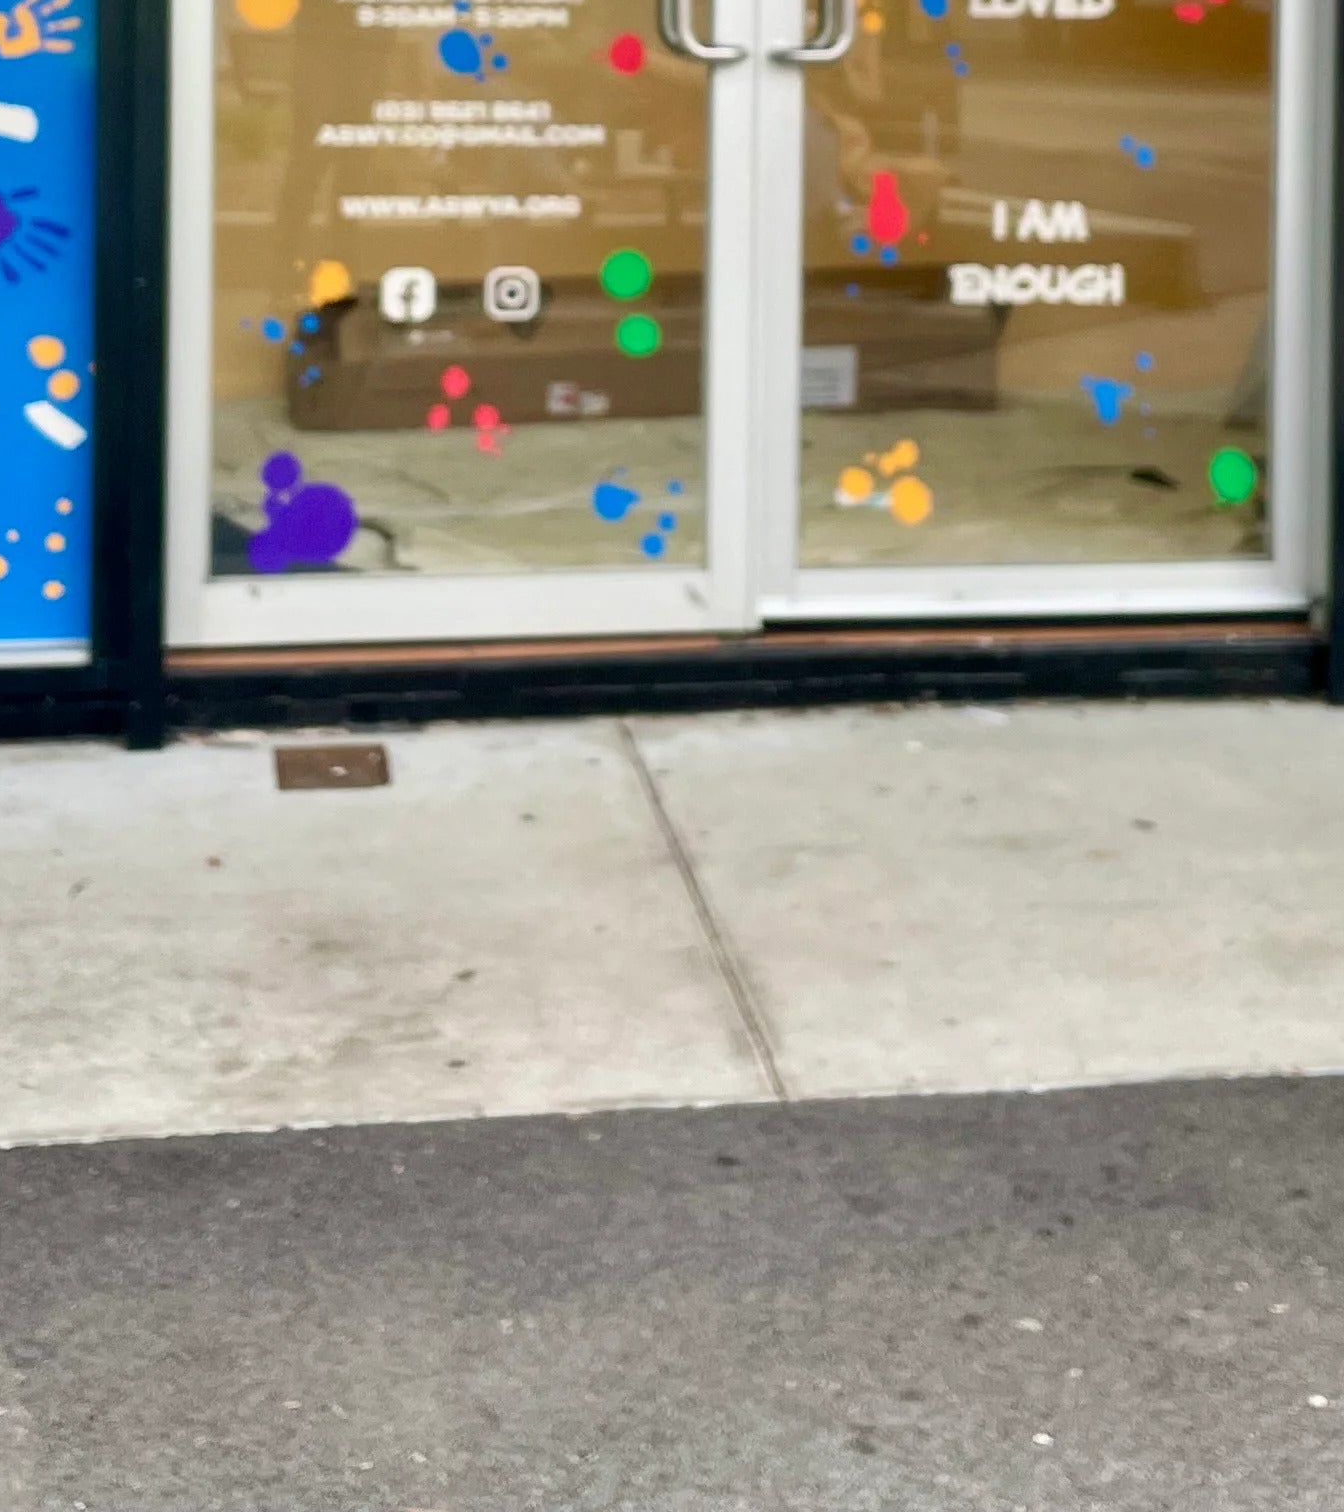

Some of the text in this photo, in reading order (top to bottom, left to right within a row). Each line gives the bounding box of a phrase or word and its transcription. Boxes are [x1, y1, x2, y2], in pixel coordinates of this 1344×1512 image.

[991, 199, 1089, 242] I AM
[949, 263, 1124, 305] ENOUGH
